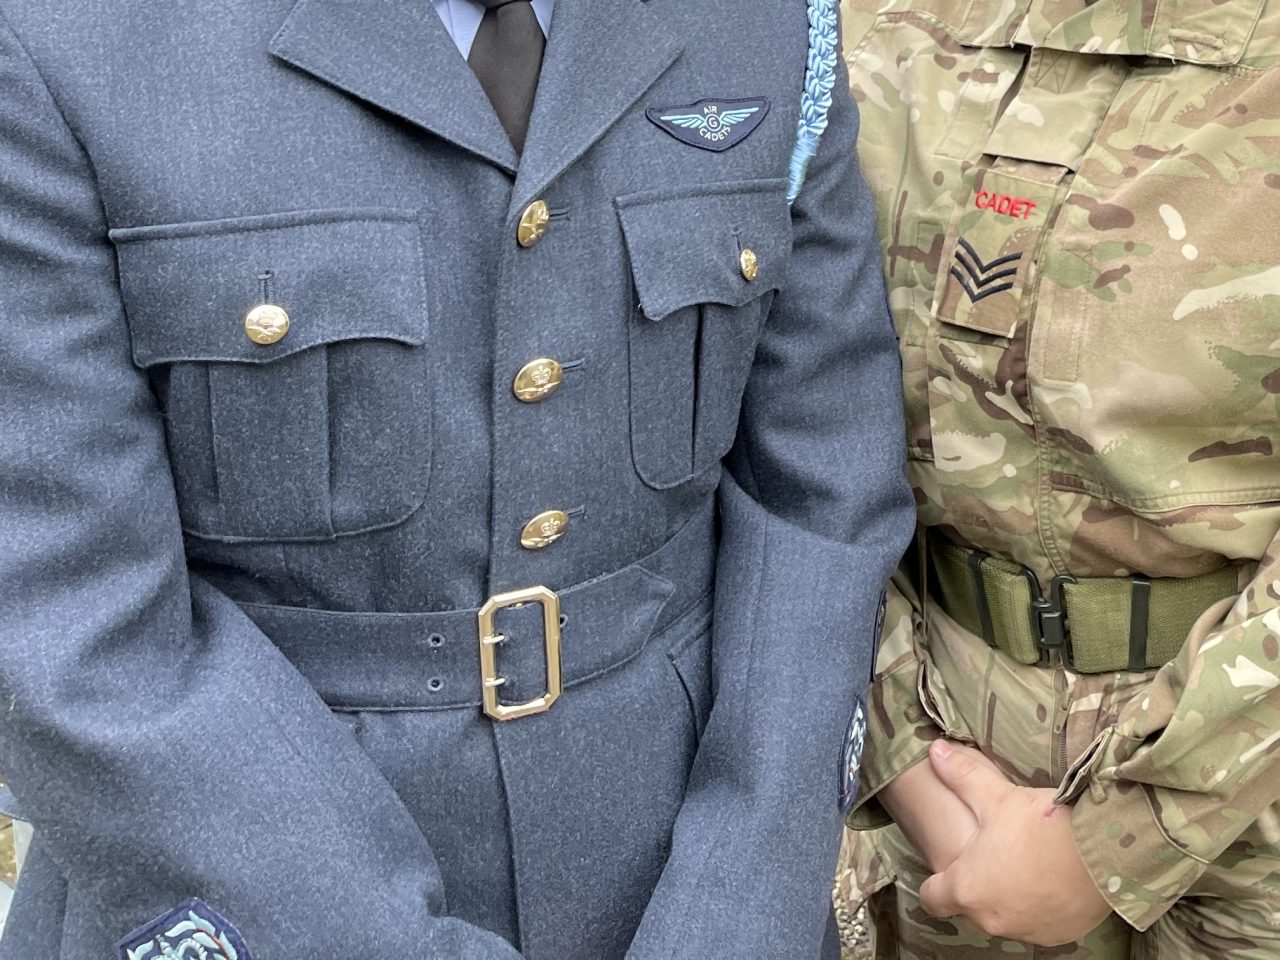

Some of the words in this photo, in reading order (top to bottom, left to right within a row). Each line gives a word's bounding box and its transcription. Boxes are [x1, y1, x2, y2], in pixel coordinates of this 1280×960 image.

[703, 105, 718, 115] AIR
[708, 116, 718, 128] G
[699, 125, 731, 142] CADETS
[975, 189, 1038, 220] CADET
